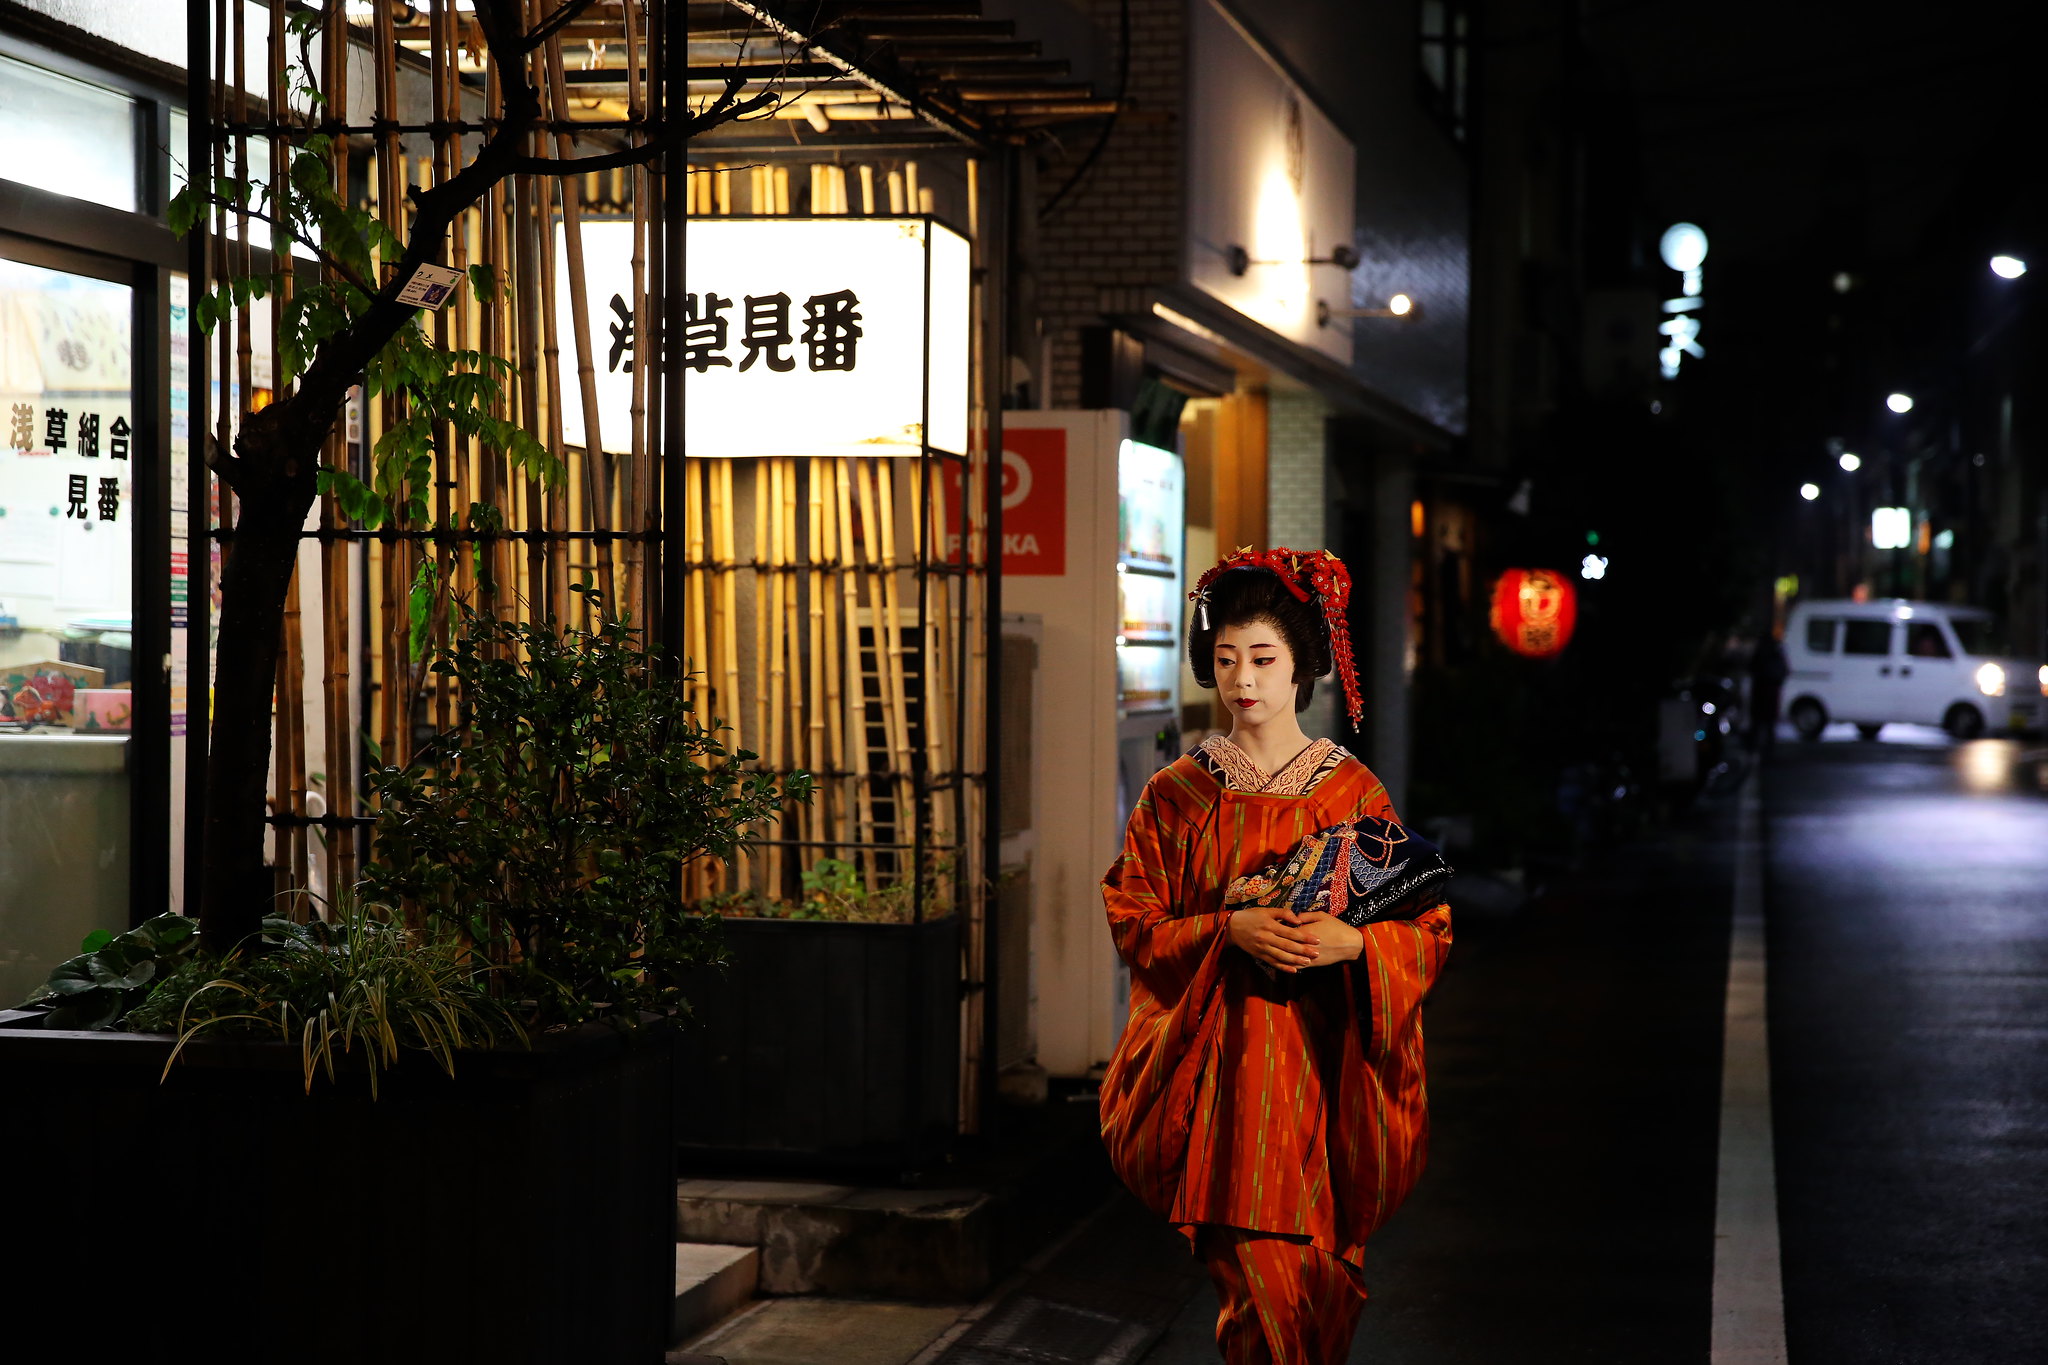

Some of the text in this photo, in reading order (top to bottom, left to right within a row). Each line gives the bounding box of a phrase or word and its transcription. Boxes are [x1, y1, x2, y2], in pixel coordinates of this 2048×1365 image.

[10, 402, 131, 461] 浅草組合
[67, 473, 119, 521] 見番
[946, 533, 1040, 555] PKA
